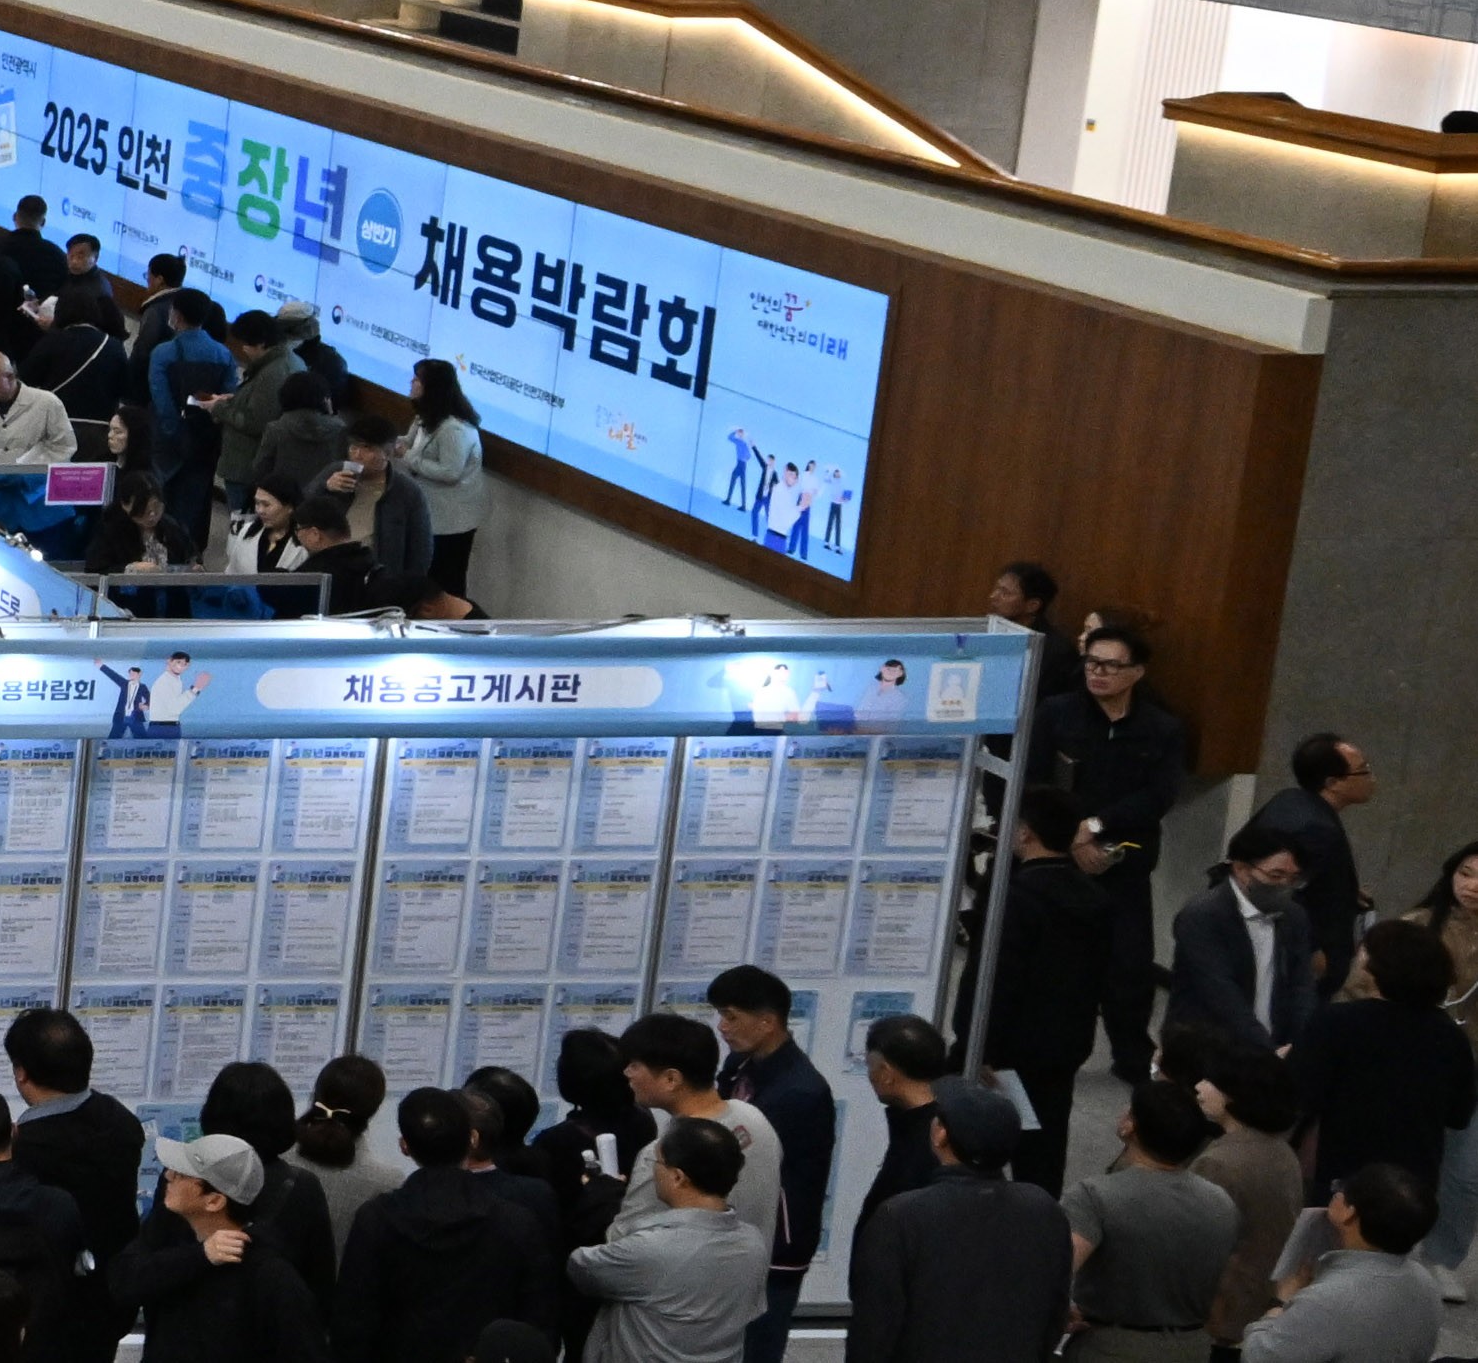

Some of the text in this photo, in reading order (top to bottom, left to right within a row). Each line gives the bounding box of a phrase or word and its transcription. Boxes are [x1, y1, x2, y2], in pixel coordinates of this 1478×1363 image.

[41, 101, 109, 176] 2025
[116, 126, 172, 200] 인천
[181, 119, 348, 265] 중장년
[414, 212, 718, 401] 채용박람회
[807, 332, 849, 361] 미래
[343, 672, 581, 704] 채용공고게시판
